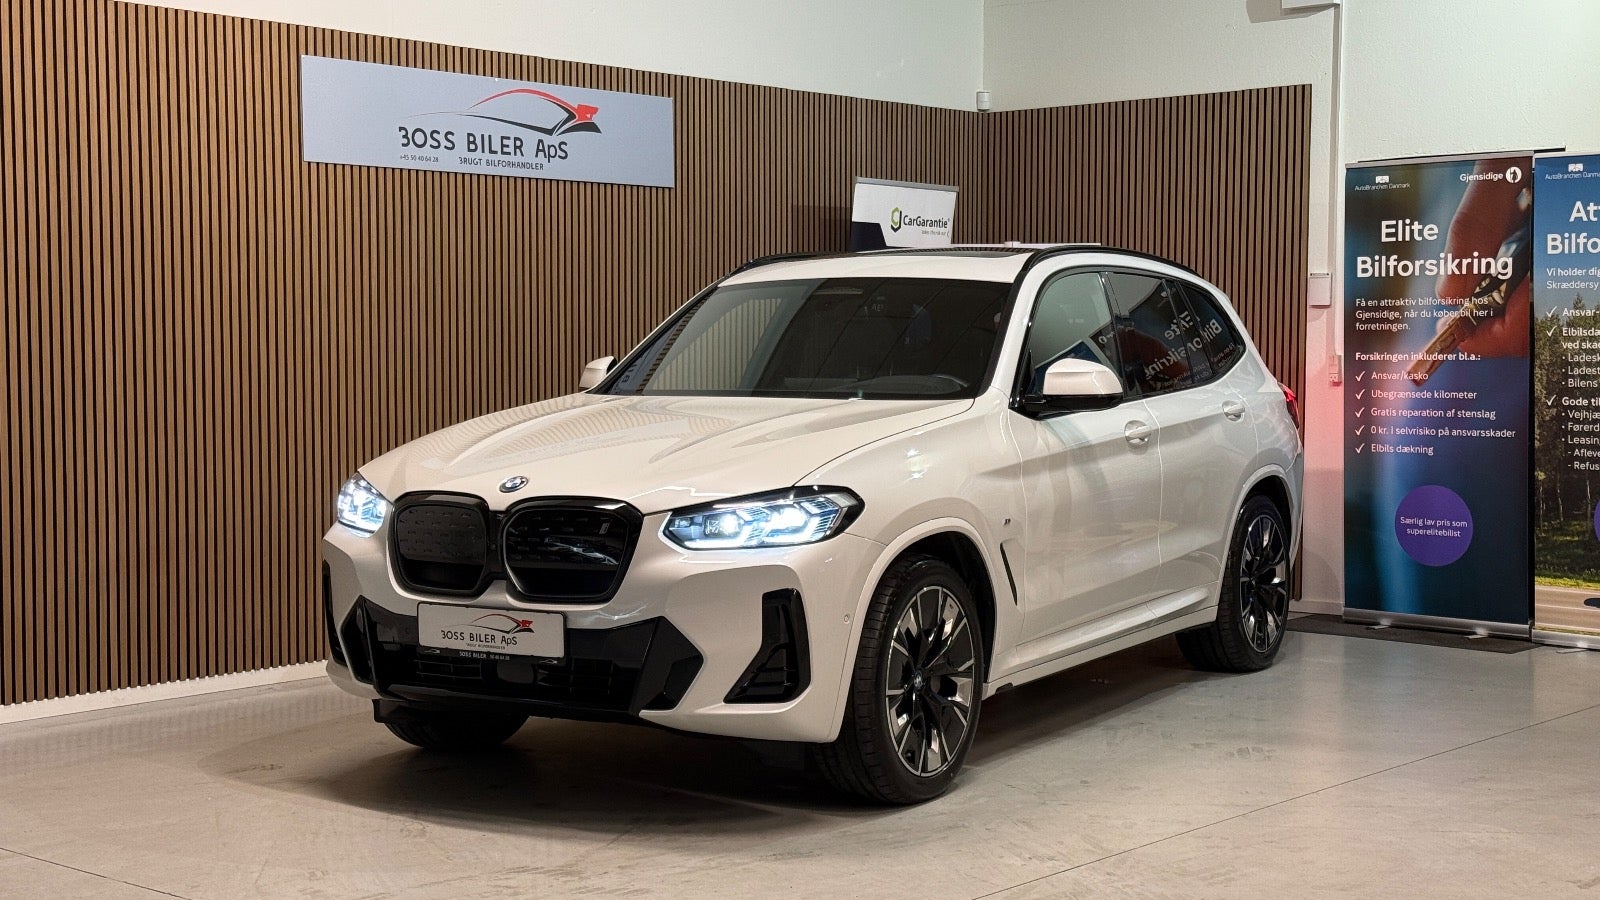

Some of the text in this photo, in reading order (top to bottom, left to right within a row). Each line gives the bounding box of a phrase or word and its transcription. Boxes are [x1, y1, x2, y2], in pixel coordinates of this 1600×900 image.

[466, 132, 524, 157] BILER
[534, 138, 569, 163] ApS
[486, 159, 544, 171] BILFORHANDLER
[1460, 171, 1504, 183] Gjensidige
[1569, 200, 1600, 222] At
[903, 215, 948, 229] CarGarantie
[1381, 218, 1439, 243] Elite
[1547, 232, 1600, 255] Bilfo
[1356, 251, 1513, 280] Bilforsikring
[1546, 267, 1555, 276] Vi
[1557, 267, 1586, 276] holder
[1546, 280, 1599, 290] Skræddersy
[1355, 296, 1488, 307] Få en attraktiv bilforsikring hos
[1355, 309, 1402, 321] Gjensidige,
[1404, 309, 1418, 318] når
[1420, 309, 1431, 318] du
[1433, 309, 1458, 318] køber
[1460, 309, 1471, 317] bil
[1473, 309, 1488, 317] her
[1355, 322, 1411, 332] forretningen.
[1562, 340, 1579, 349] ved
[1355, 352, 1481, 362] Forsikringen inkluderer bl.a.:
[1371, 371, 1429, 380] Ansvar/kasko
[1568, 378, 1598, 388] Bilens
[1371, 389, 1477, 400] Ubegrænsede kilometer
[1562, 396, 1589, 406] Gode
[1370, 407, 1496, 420] Gratis reparation af stenslag
[1370, 425, 1376, 434] 0
[1378, 426, 1389, 434] kr.
[1395, 426, 1436, 435] selvrisiko
[1438, 426, 1449, 437] på
[1451, 428, 1516, 438] ansvarsskader
[1567, 422, 1600, 432] Førerd
[1567, 435, 1600, 445] Leasin
[1371, 443, 1434, 456] Elbils dækning
[1573, 461, 1600, 471] Refus
[1400, 516, 1468, 528] Særlig lav pris som
[1406, 528, 1462, 538] superelitebilist
[469, 632, 496, 643] BILER
[501, 635, 518, 646] ApS
